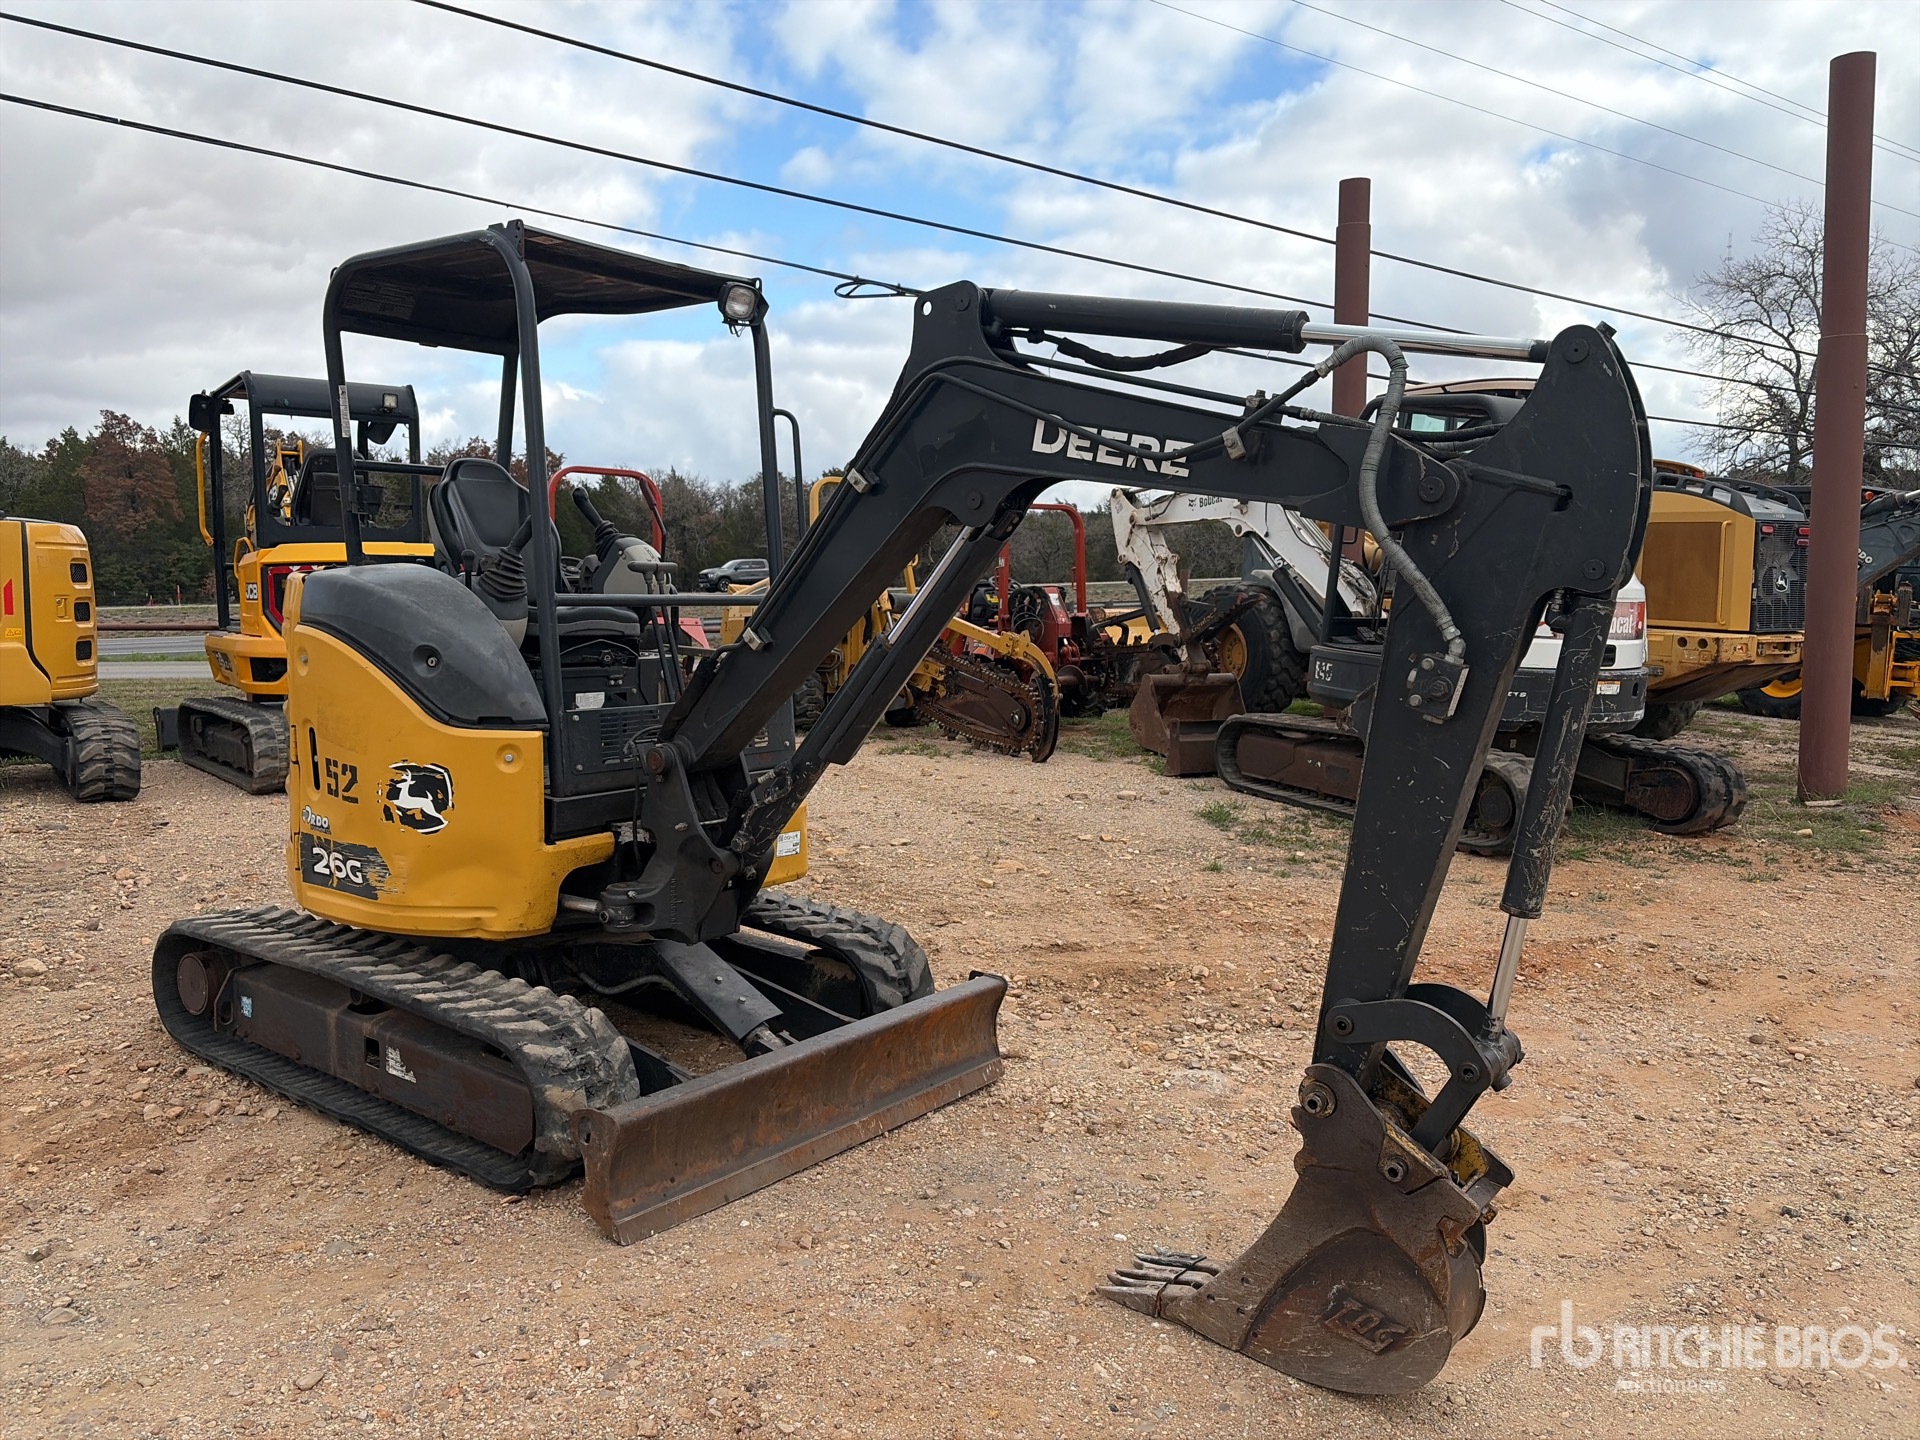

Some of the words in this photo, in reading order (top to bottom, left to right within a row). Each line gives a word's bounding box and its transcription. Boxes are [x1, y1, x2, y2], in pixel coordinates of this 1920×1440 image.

[1032, 413, 1195, 478] DEERE
[245, 583, 258, 600] JCB
[325, 757, 359, 804] 52
[312, 847, 364, 884] 26G
